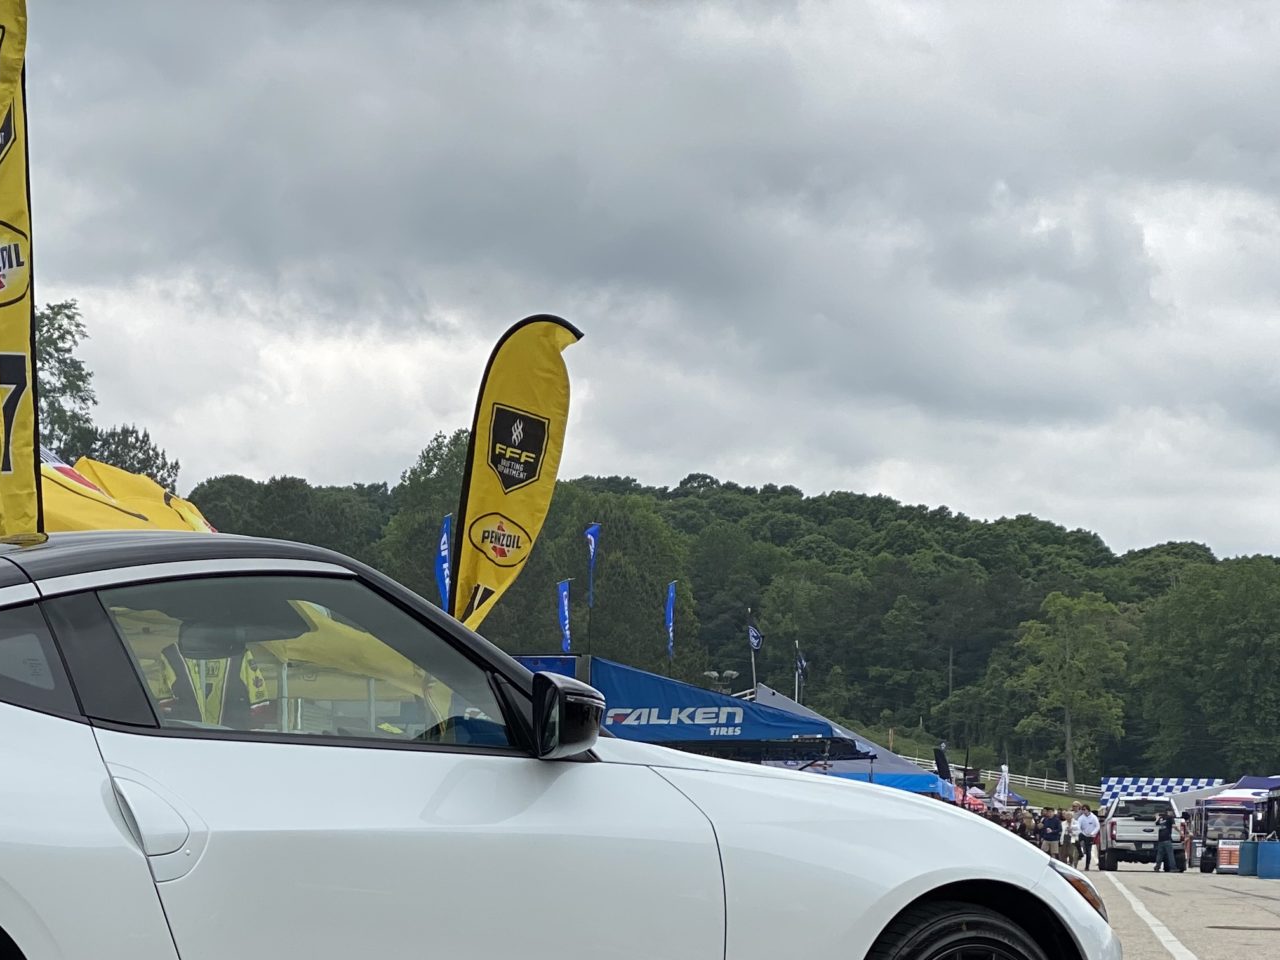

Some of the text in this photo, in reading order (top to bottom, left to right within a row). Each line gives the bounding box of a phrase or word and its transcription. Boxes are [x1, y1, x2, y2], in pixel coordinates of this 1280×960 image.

[495, 443, 536, 463] FFF
[605, 706, 744, 726] FALKEN
[709, 726, 742, 736] TIRES
